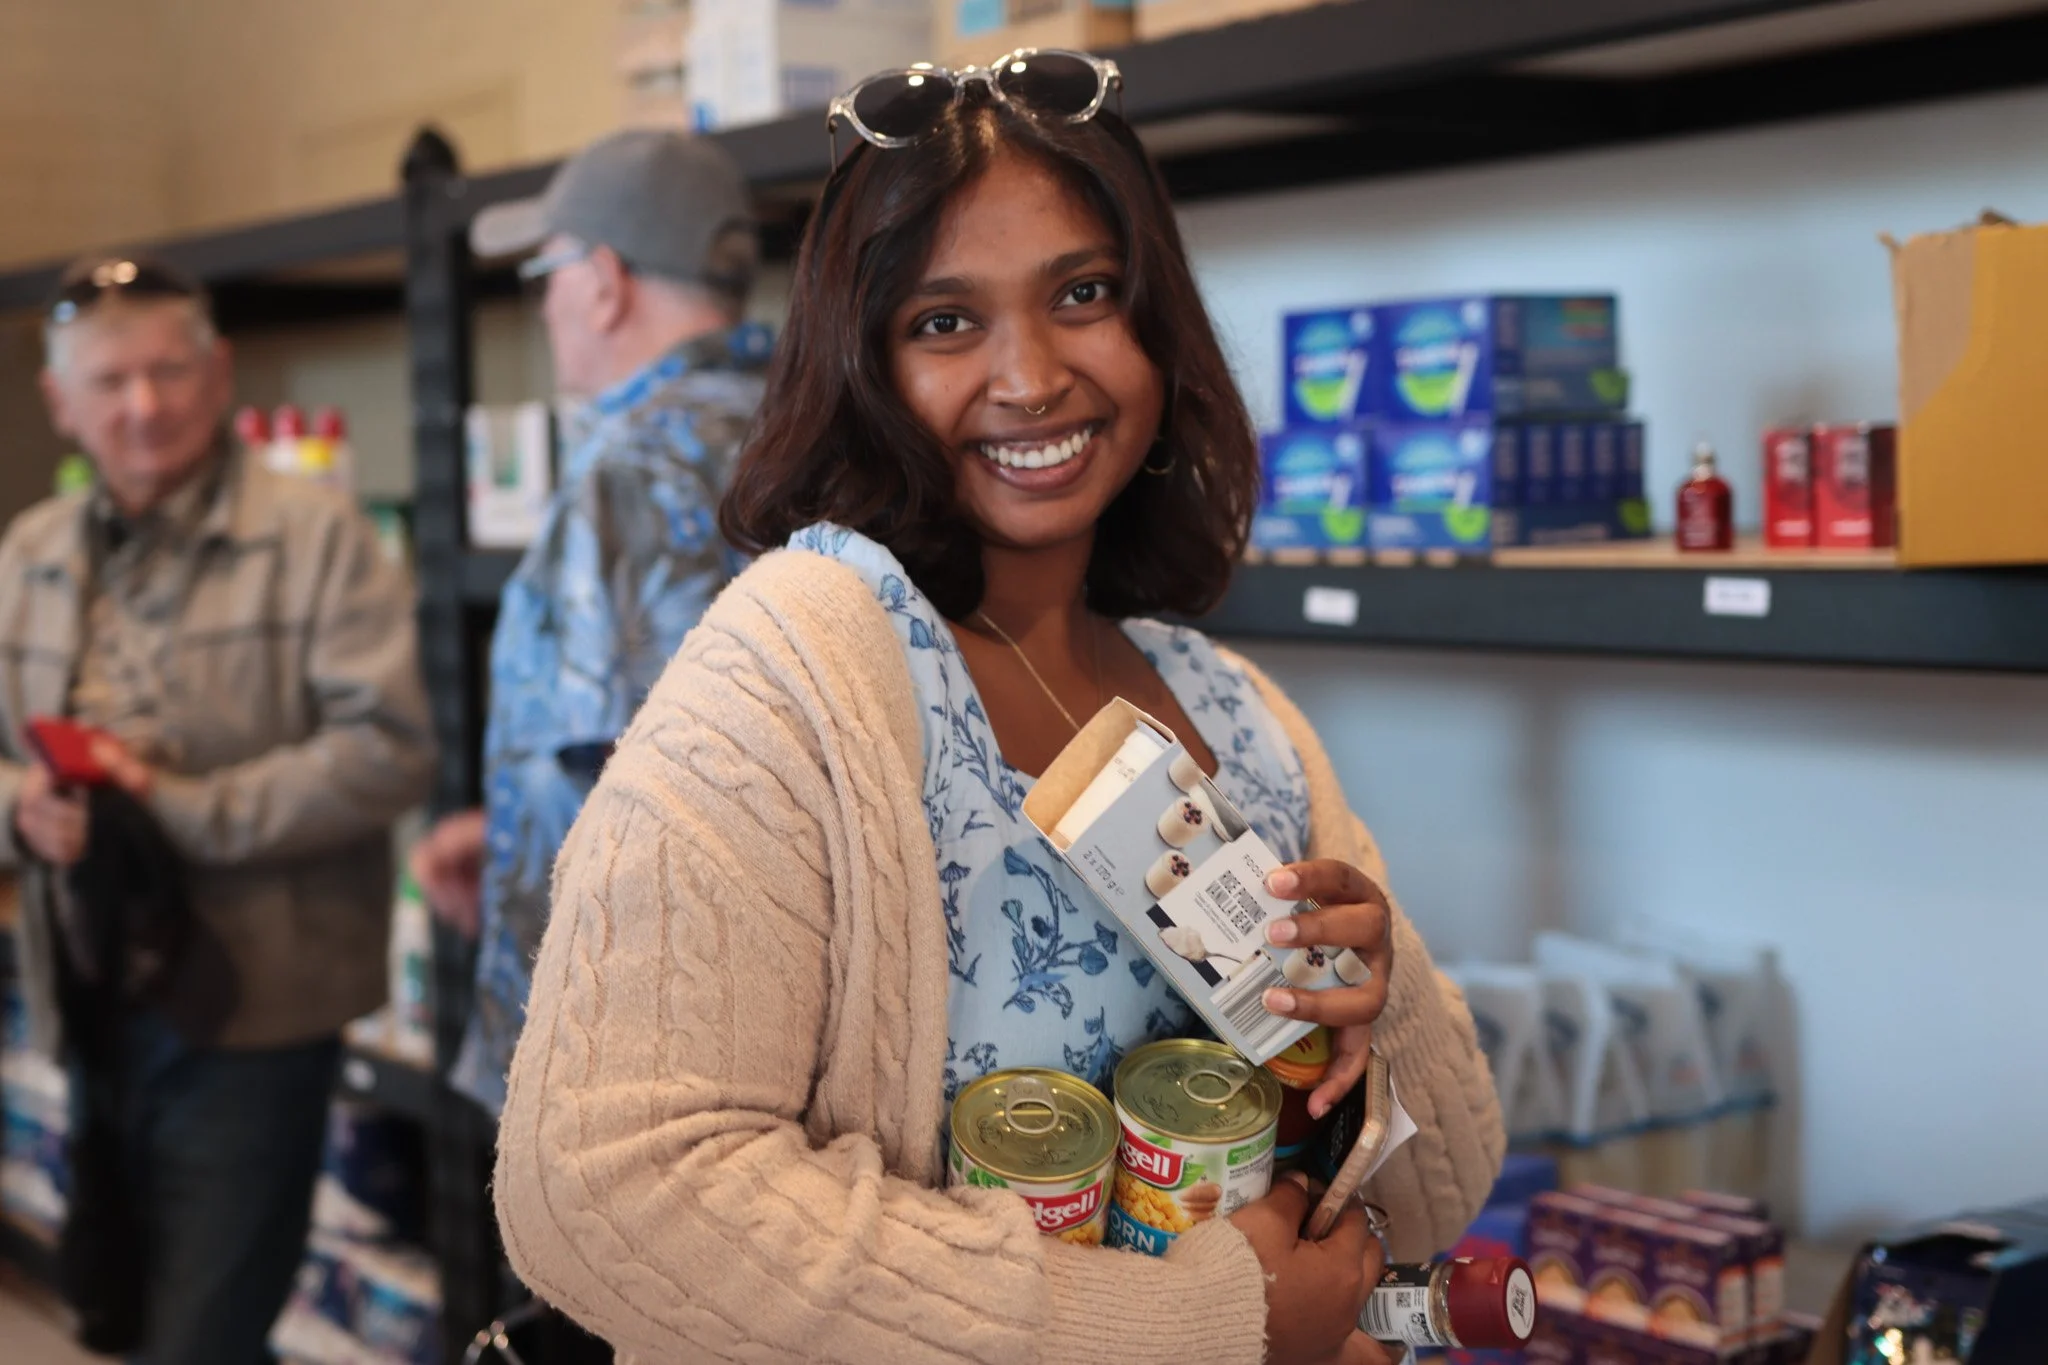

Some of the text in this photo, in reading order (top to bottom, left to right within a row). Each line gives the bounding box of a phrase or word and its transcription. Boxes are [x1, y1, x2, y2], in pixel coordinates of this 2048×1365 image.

[1244, 853, 1264, 878] FOOD
[1204, 879, 1239, 917] VANILLA
[1230, 910, 1256, 937] BEAN
[1217, 869, 1242, 896] RICE
[1232, 887, 1267, 925] PUDDING
[1109, 1209, 1156, 1254] ORN
